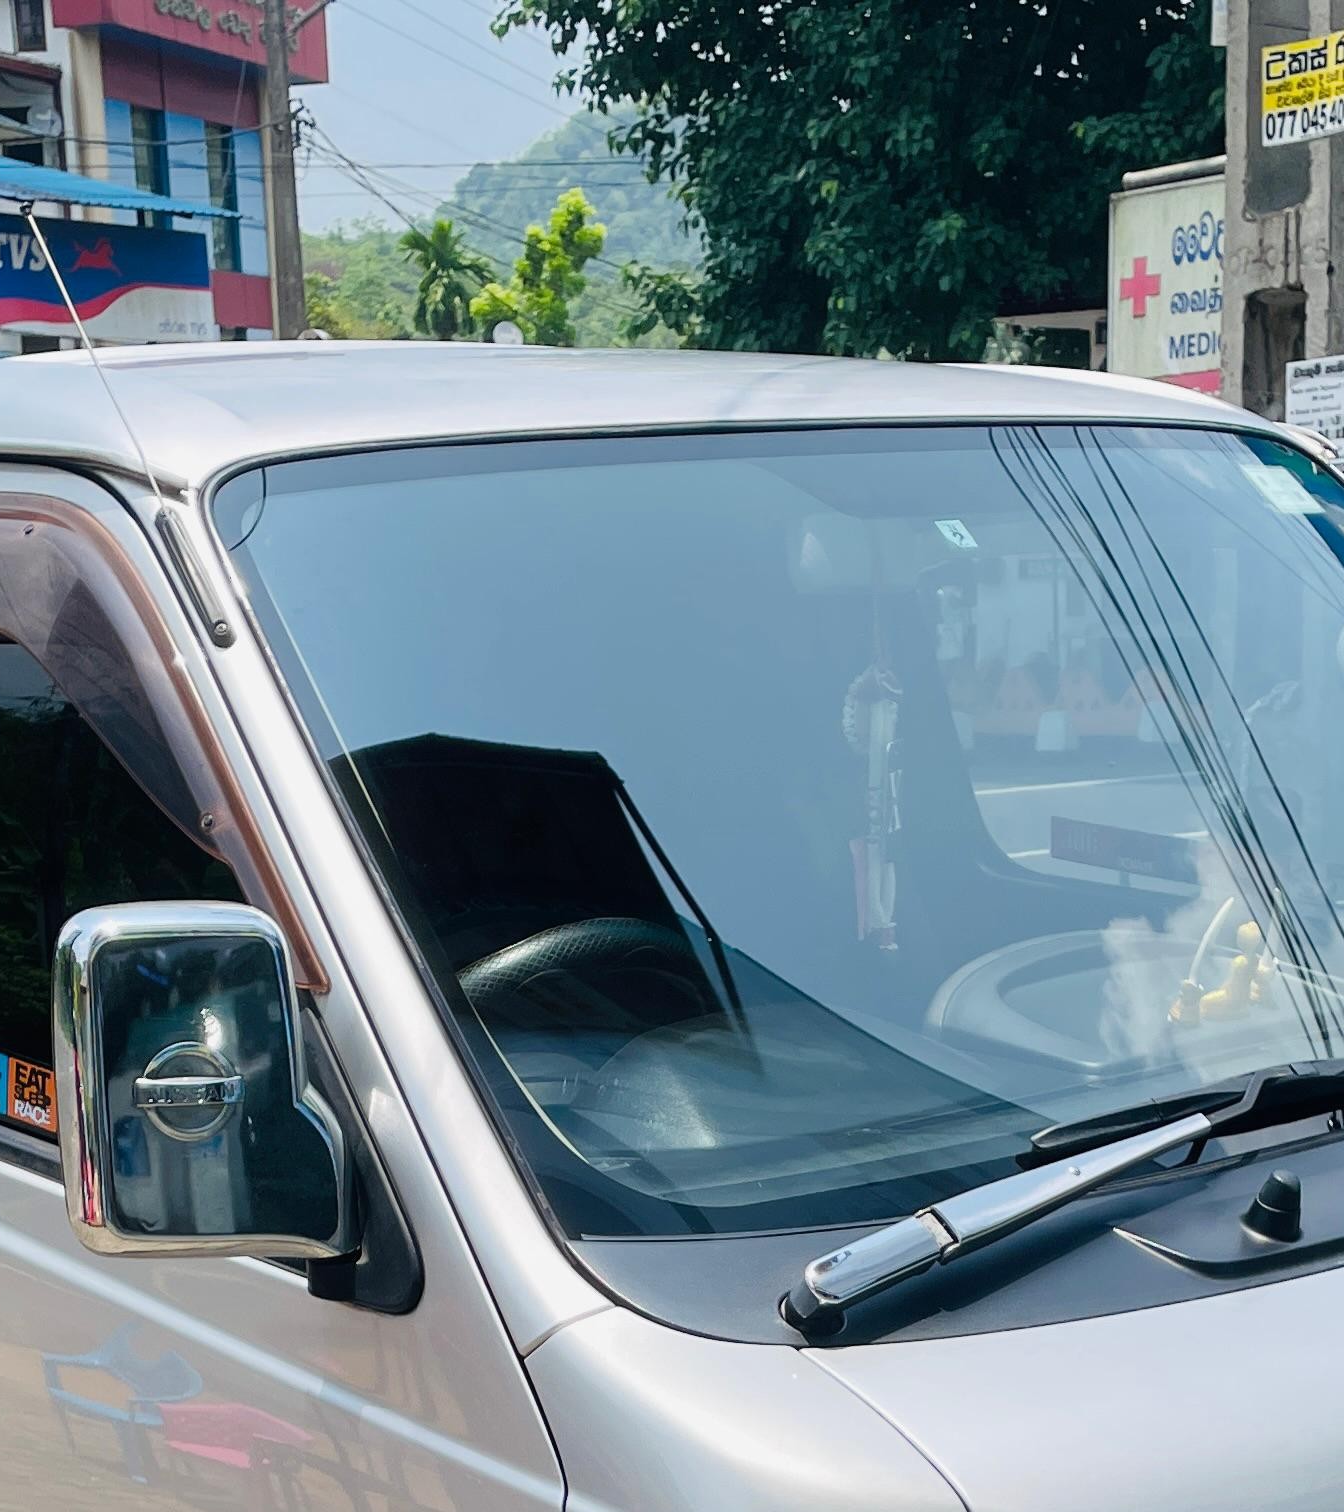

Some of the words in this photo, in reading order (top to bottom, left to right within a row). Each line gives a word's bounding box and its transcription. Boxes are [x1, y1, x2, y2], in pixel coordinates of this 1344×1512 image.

[1266, 110, 1297, 140] 077
[15, 1060, 51, 1095] EAT
[14, 1098, 51, 1126] RACE
